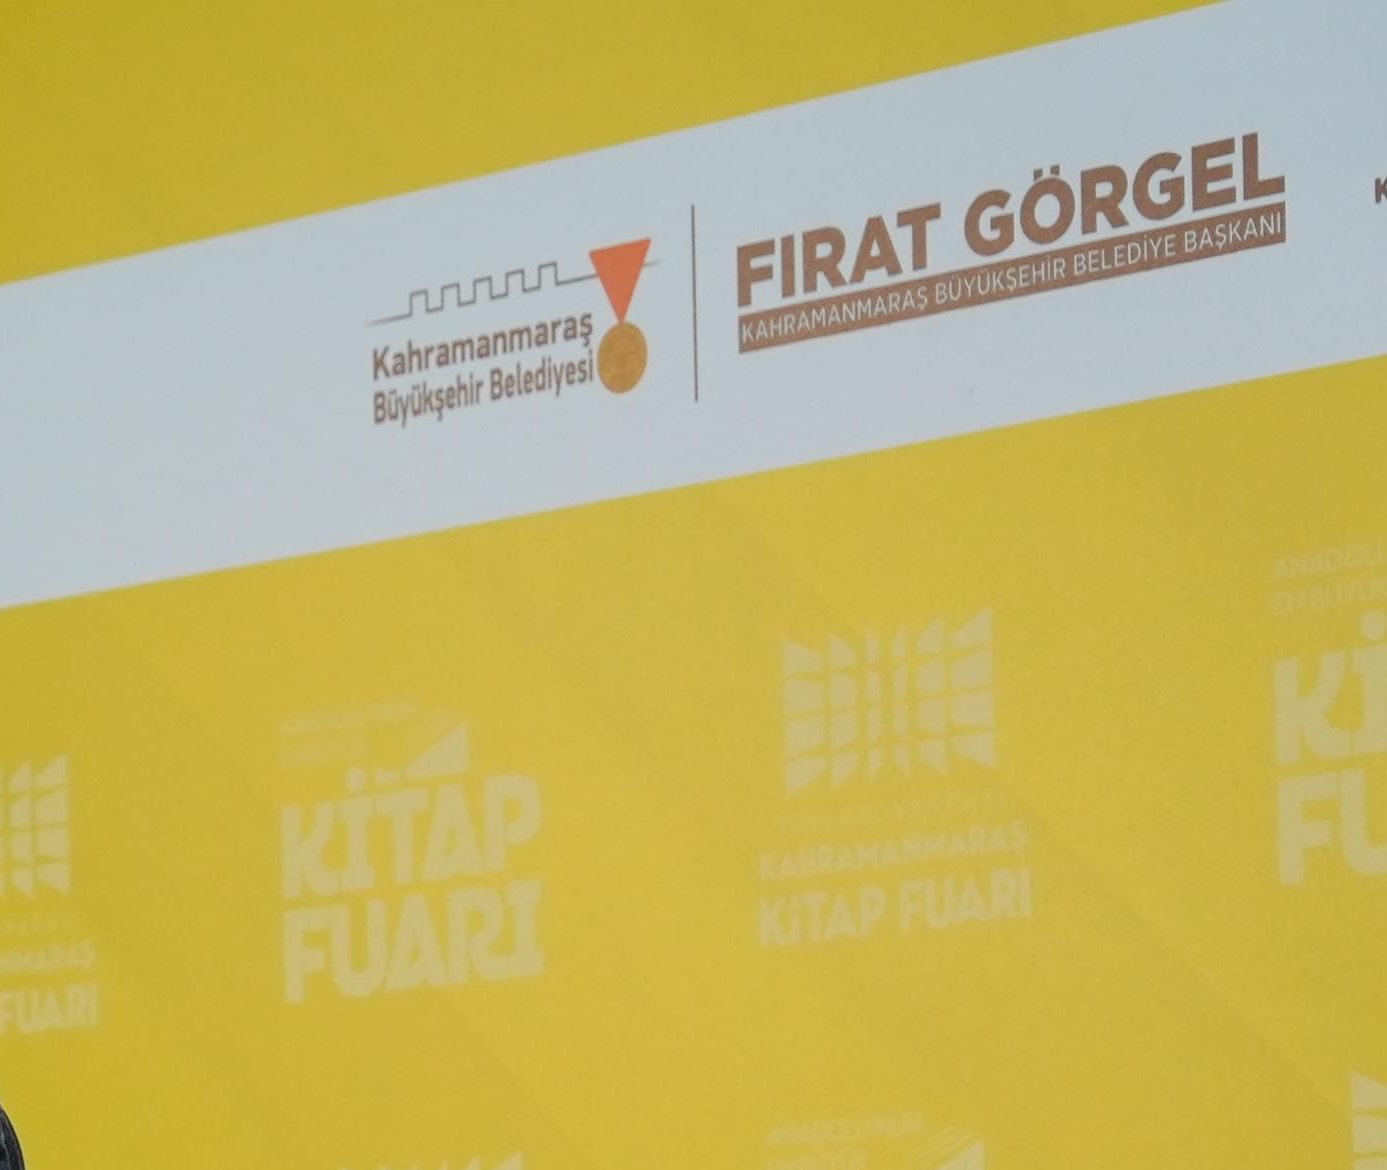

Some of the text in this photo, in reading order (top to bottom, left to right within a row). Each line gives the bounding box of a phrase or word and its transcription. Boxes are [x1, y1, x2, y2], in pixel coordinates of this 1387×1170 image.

[737, 132, 1286, 307] FIRAT GÖRGEL
[741, 211, 1283, 345] KAHRAMANMARAŞ BÜYÜKŞEHİR BELEDİYE BAŞKANI
[372, 312, 594, 381] Kahramanmaraş
[373, 350, 594, 428] Büyükşehir Belediyesi
[283, 879, 546, 1004] FUARI
[900, 867, 1032, 933] FUARI
